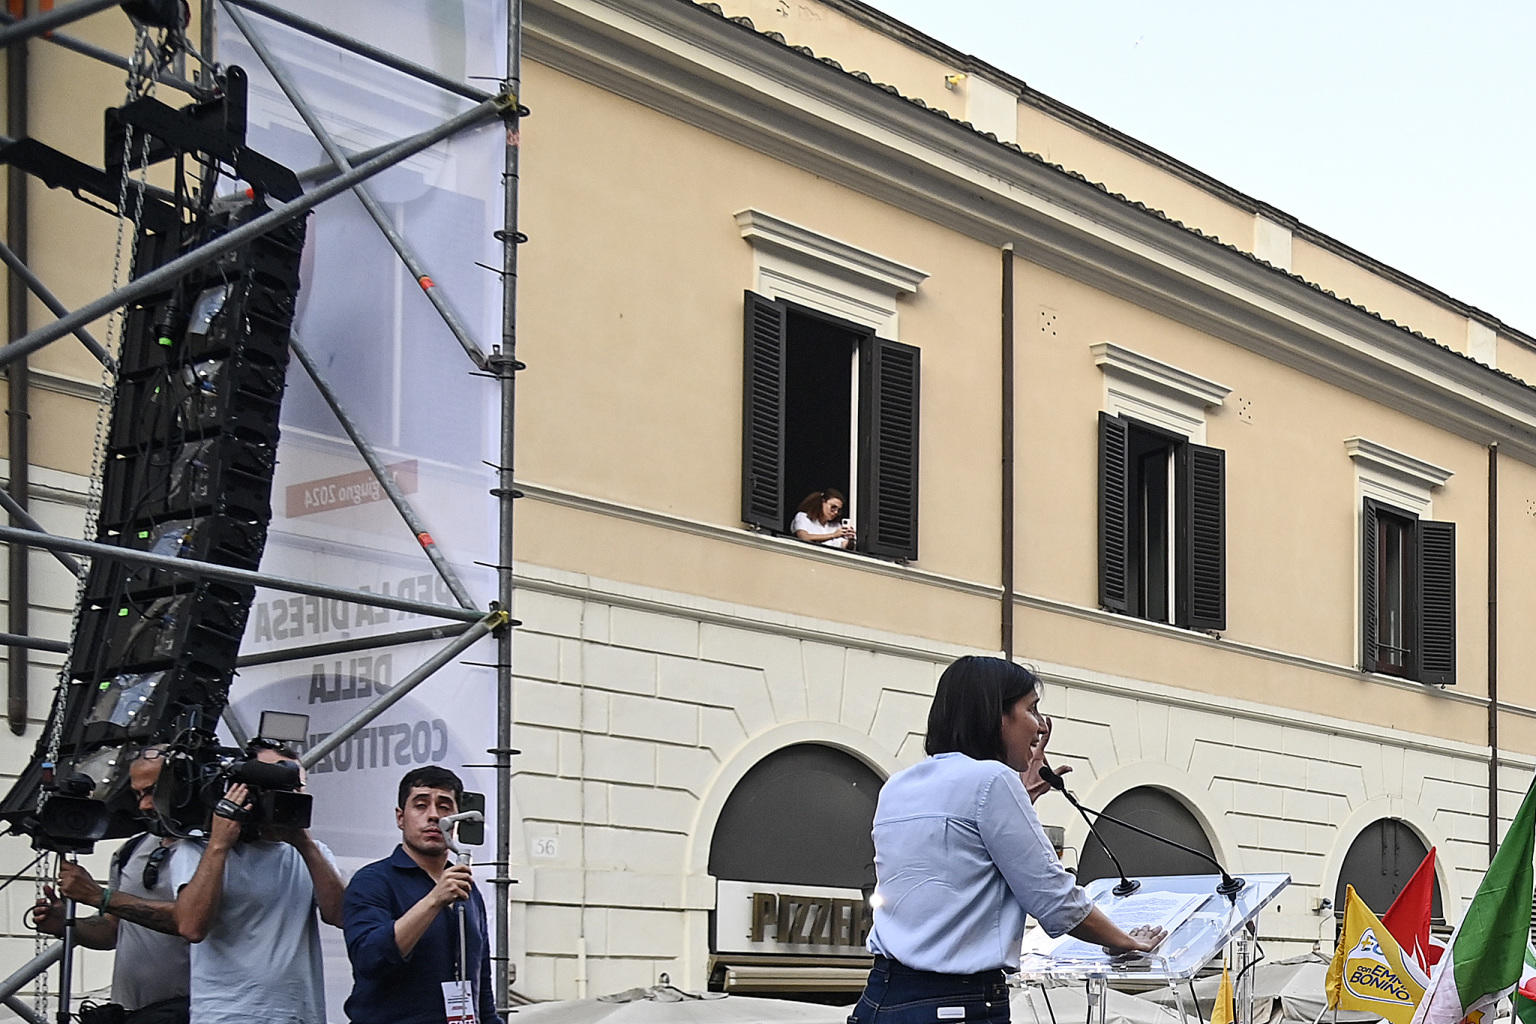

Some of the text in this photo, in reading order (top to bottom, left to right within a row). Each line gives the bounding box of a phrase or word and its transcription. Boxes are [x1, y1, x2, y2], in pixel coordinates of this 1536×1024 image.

[536, 838, 556, 856] 56
[751, 892, 869, 946] PIZZER
[1357, 965, 1372, 973] con
[1350, 971, 1410, 1001] BONINO
